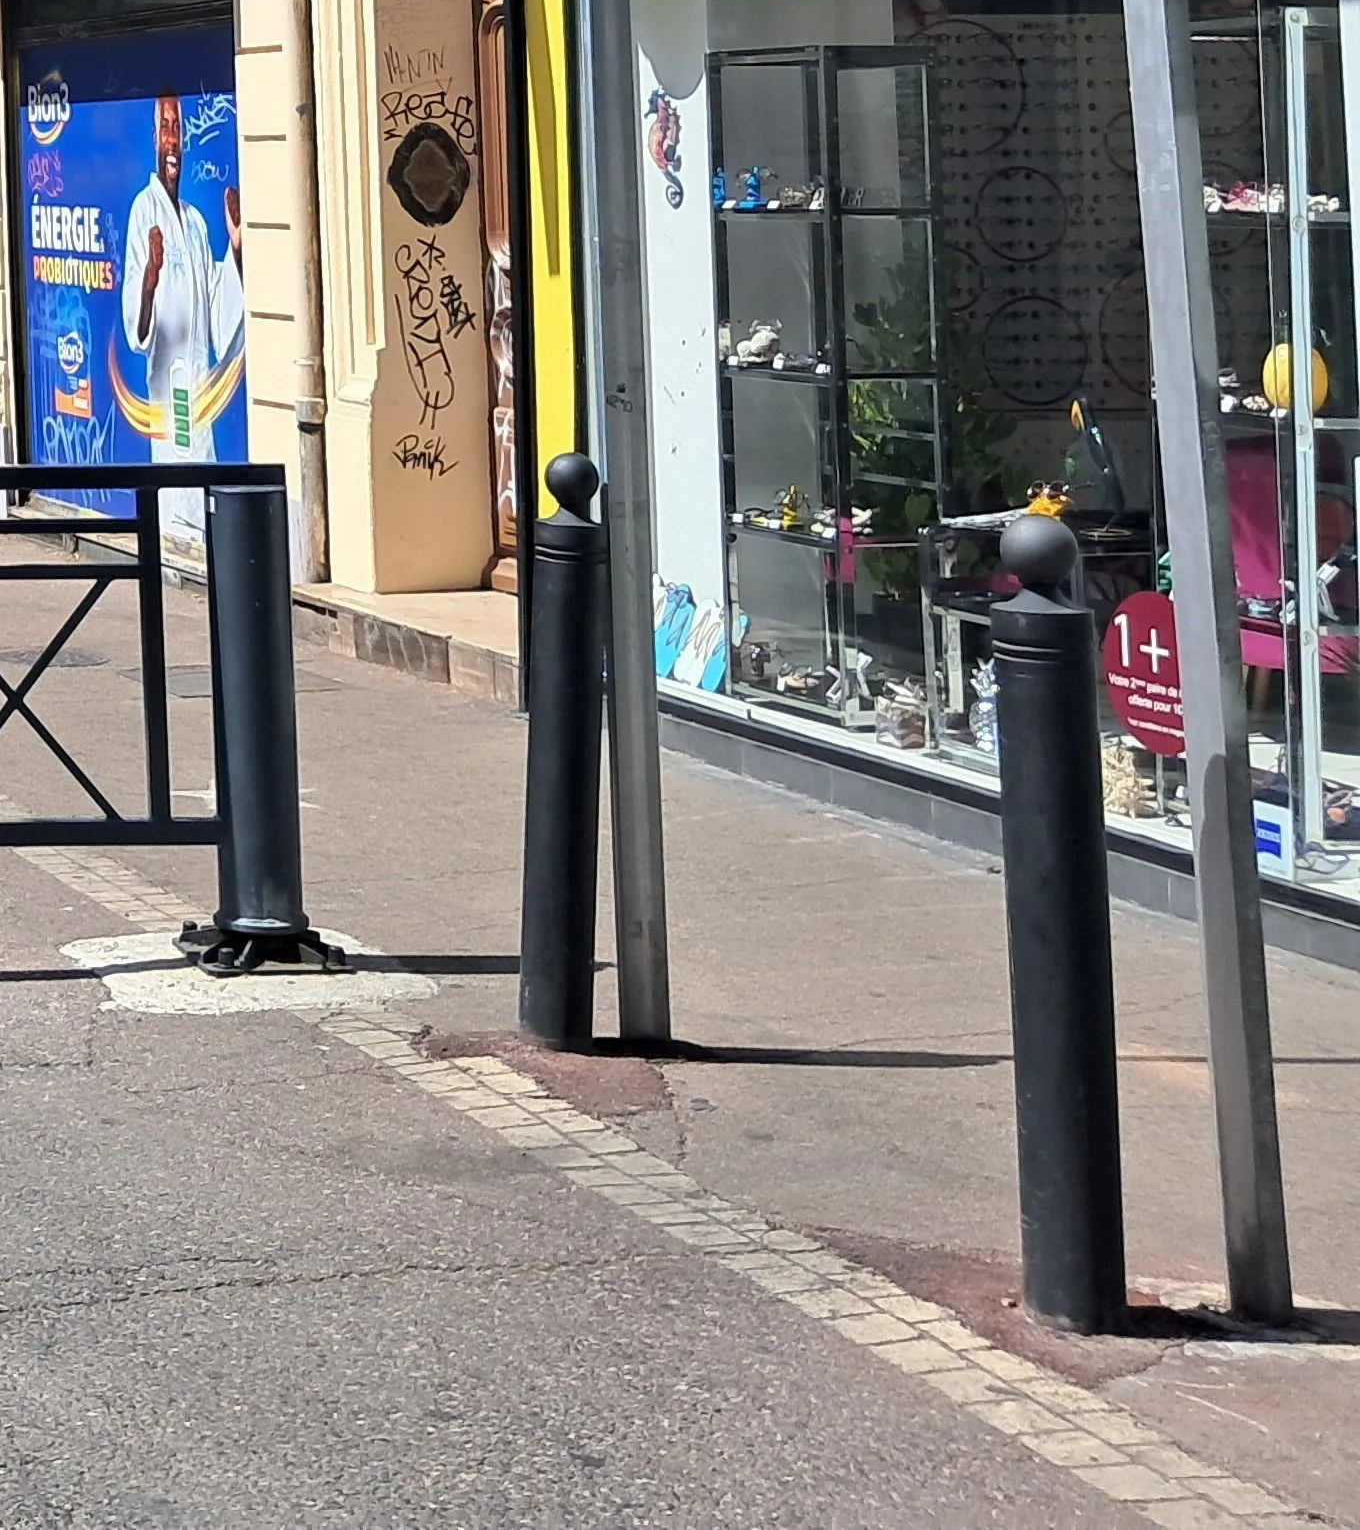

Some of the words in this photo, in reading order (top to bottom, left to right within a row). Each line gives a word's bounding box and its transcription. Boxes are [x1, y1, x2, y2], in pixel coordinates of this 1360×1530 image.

[28, 83, 70, 122] Bion3
[31, 194, 101, 253] ÉNERGIE
[33, 256, 114, 294] PROBIOTIQUES
